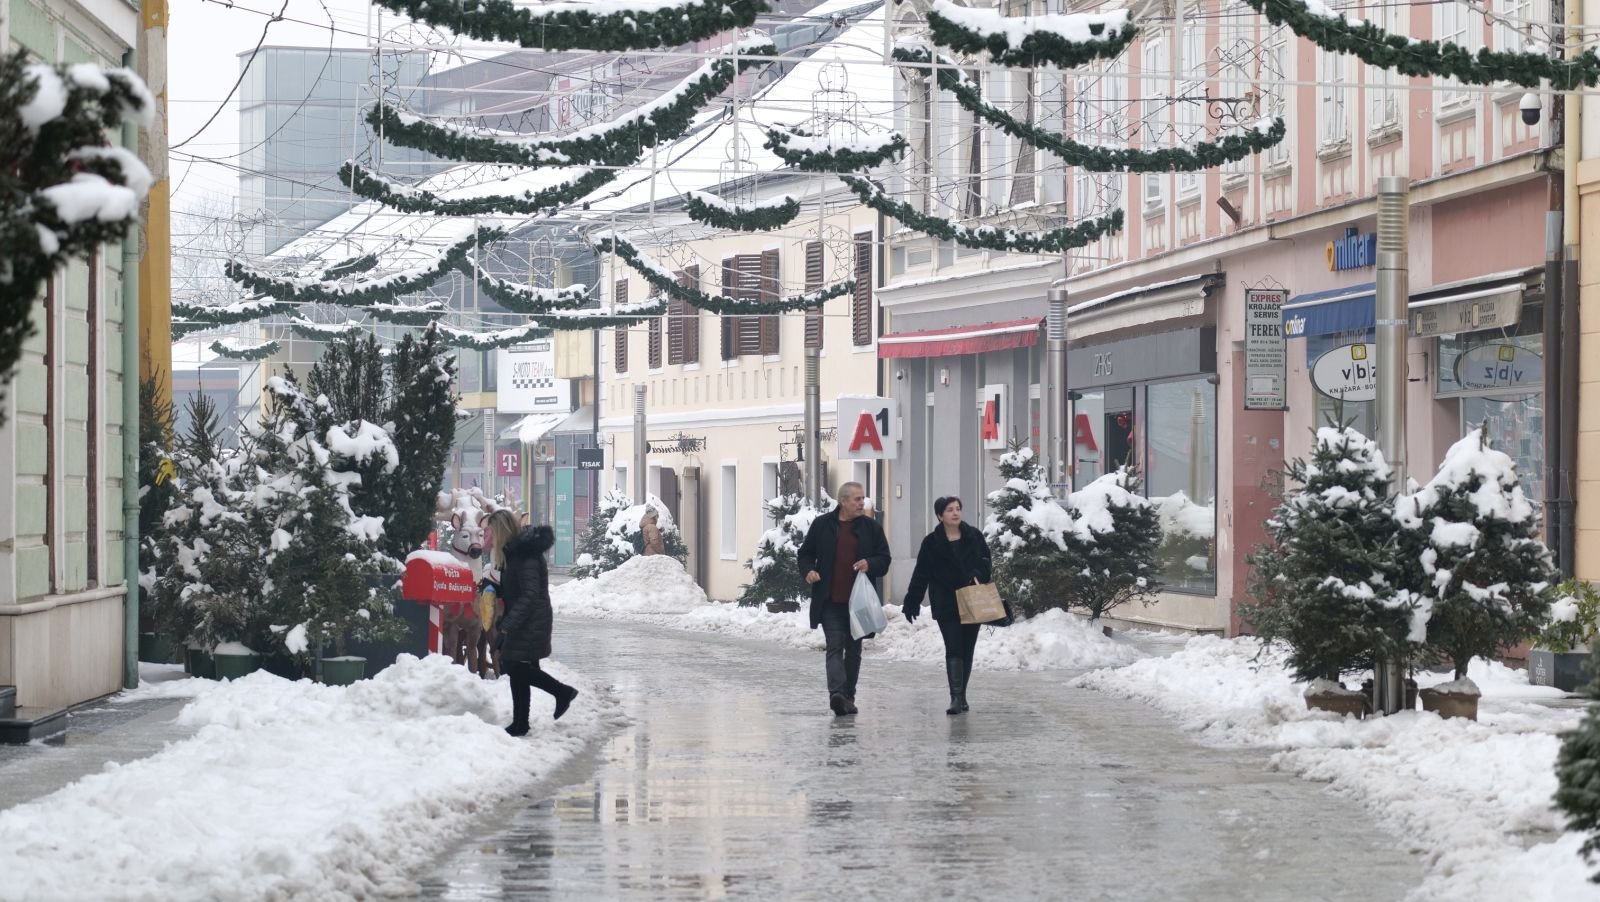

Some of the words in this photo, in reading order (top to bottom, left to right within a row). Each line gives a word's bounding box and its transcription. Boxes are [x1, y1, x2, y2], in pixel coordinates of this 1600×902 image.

[1335, 227, 1370, 272] mlinar
[1250, 294, 1281, 303] EXPRES
[848, 407, 889, 452] A1
[502, 454, 518, 473] T
